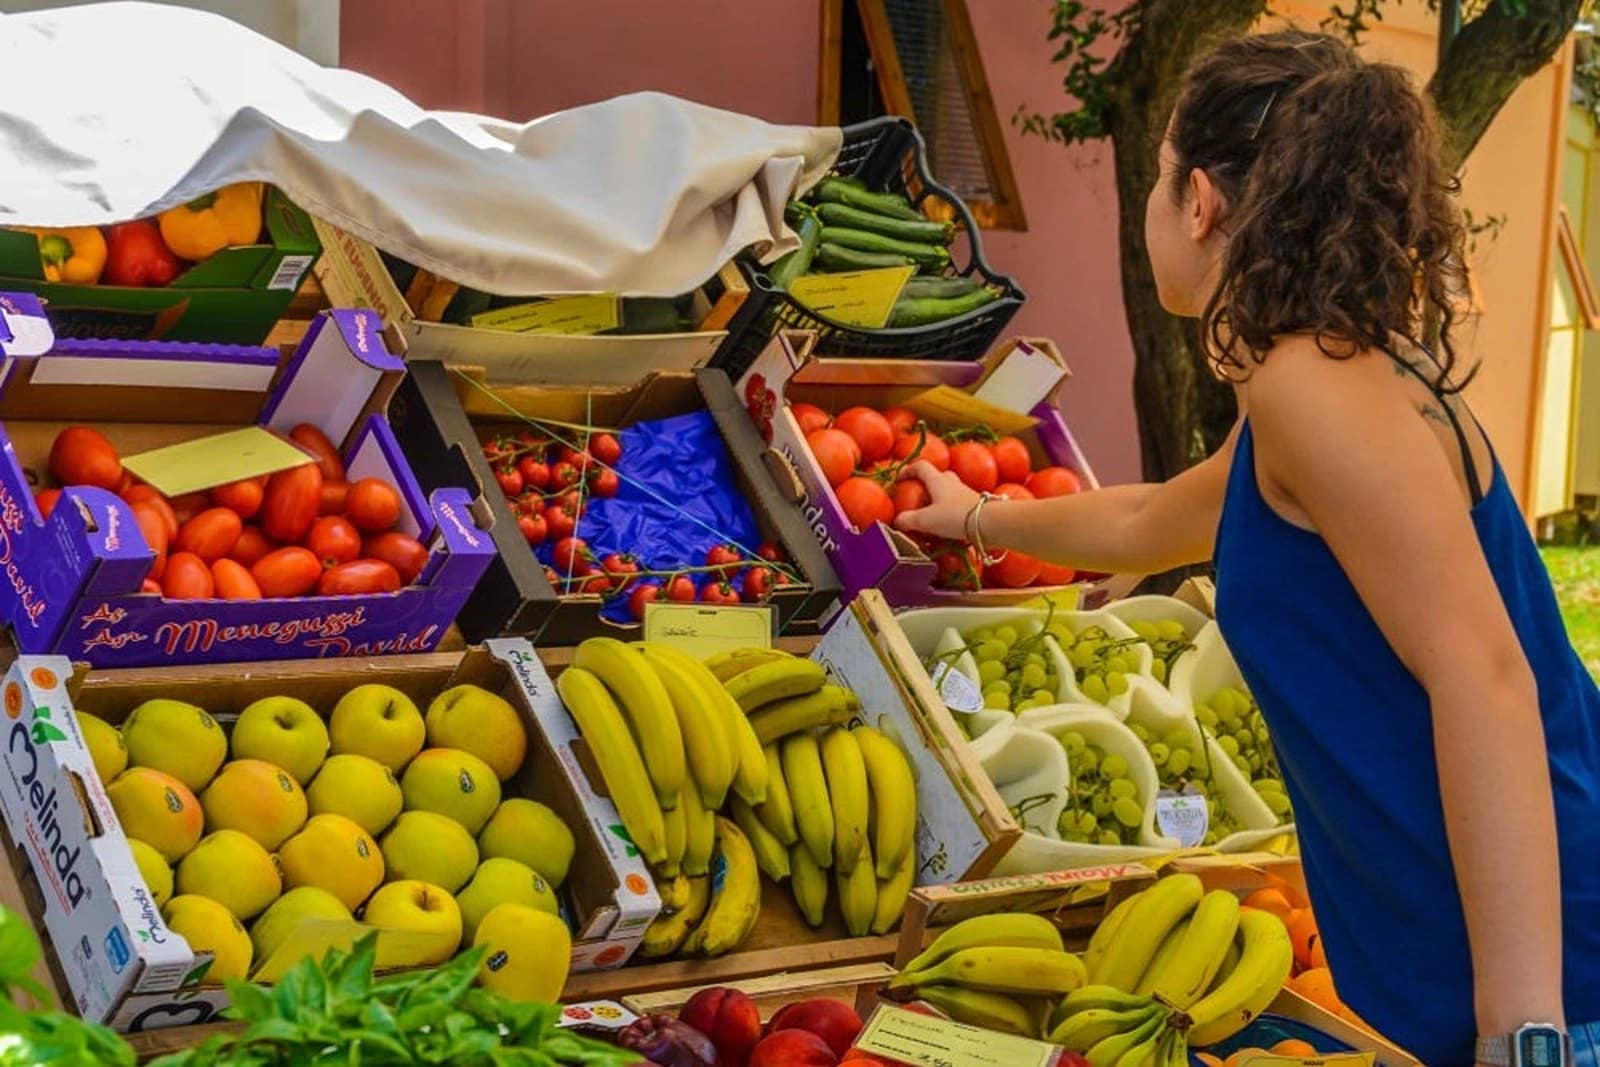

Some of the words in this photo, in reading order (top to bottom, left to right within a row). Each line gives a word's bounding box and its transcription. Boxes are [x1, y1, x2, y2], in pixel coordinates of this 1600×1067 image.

[508, 650, 538, 697] Melinda
[9, 721, 86, 911] Melinda
[134, 887, 167, 945] Melinda
